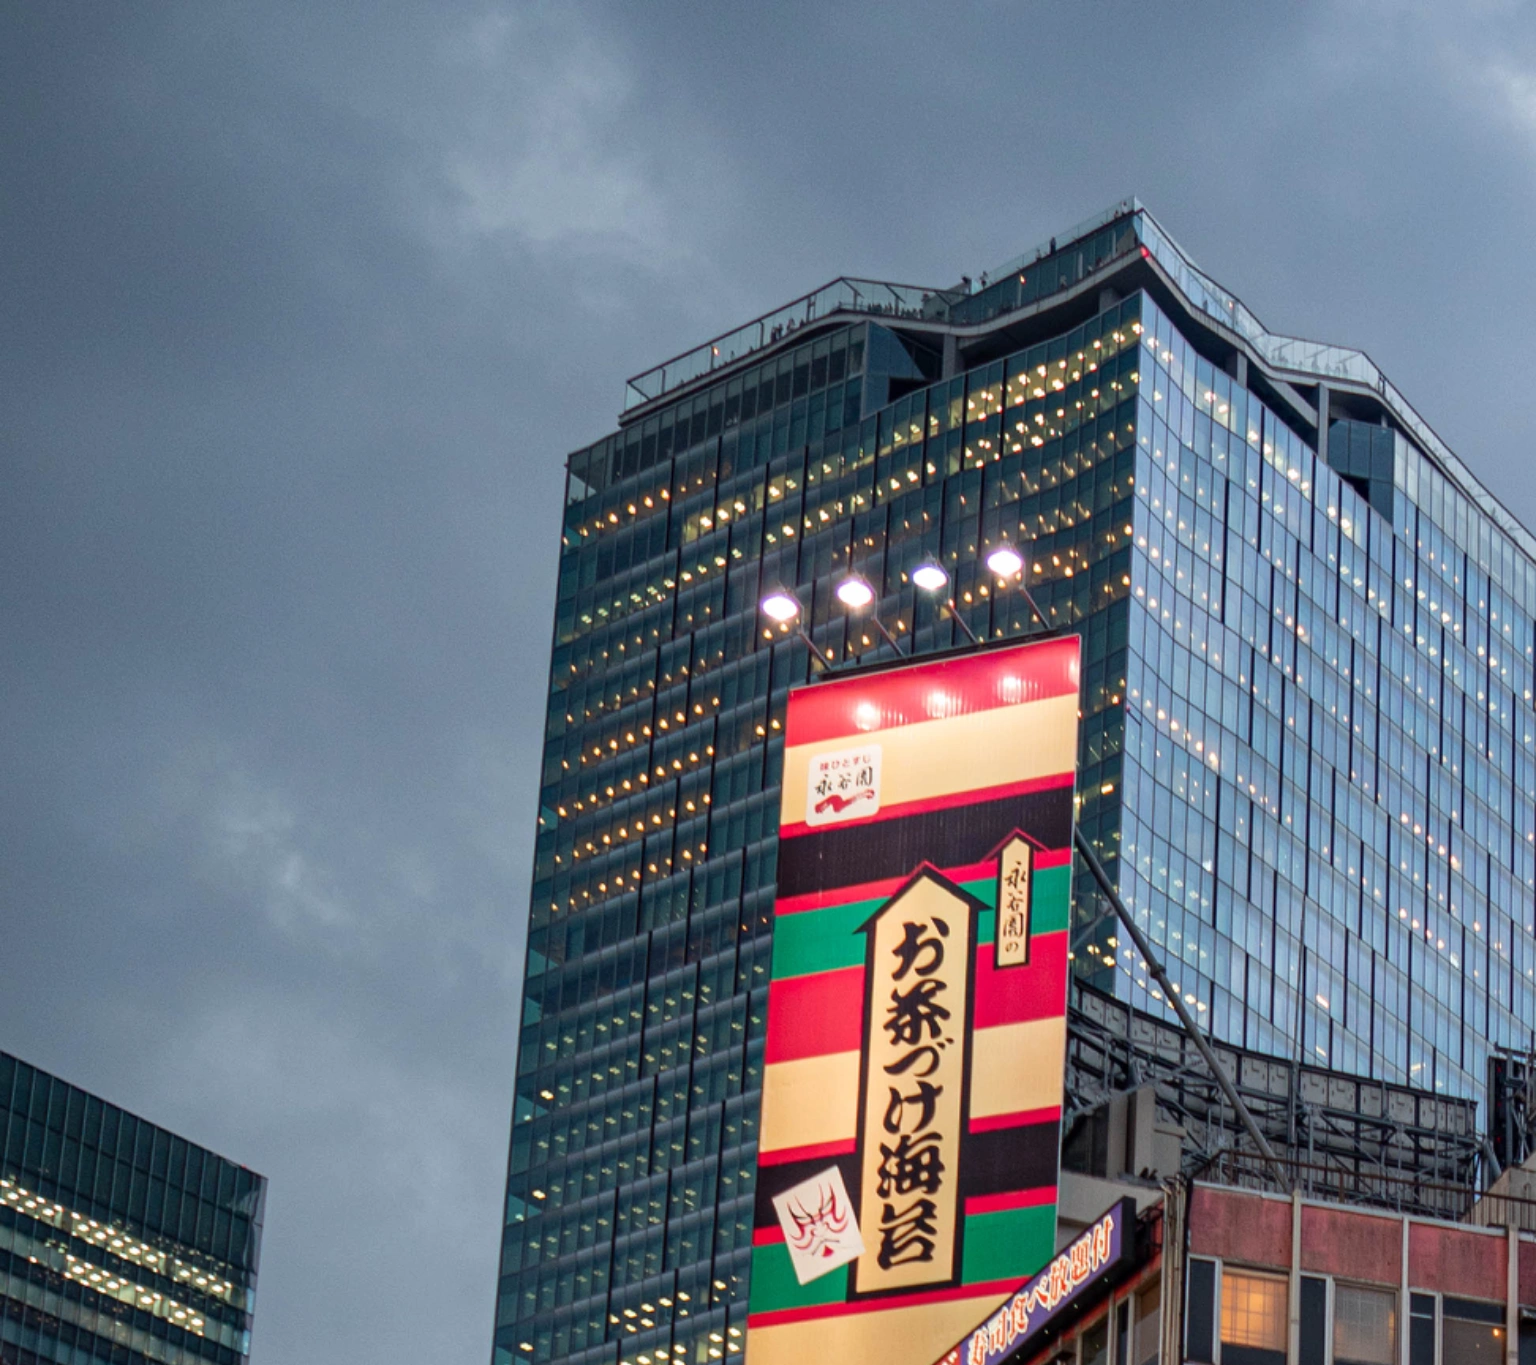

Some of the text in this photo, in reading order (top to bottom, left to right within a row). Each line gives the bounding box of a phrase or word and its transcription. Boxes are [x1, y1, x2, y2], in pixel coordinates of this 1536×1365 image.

[813, 765, 874, 798] 永谷園
[1000, 860, 1027, 954] 永谷園の
[875, 915, 957, 1271] お茶づけ海苔
